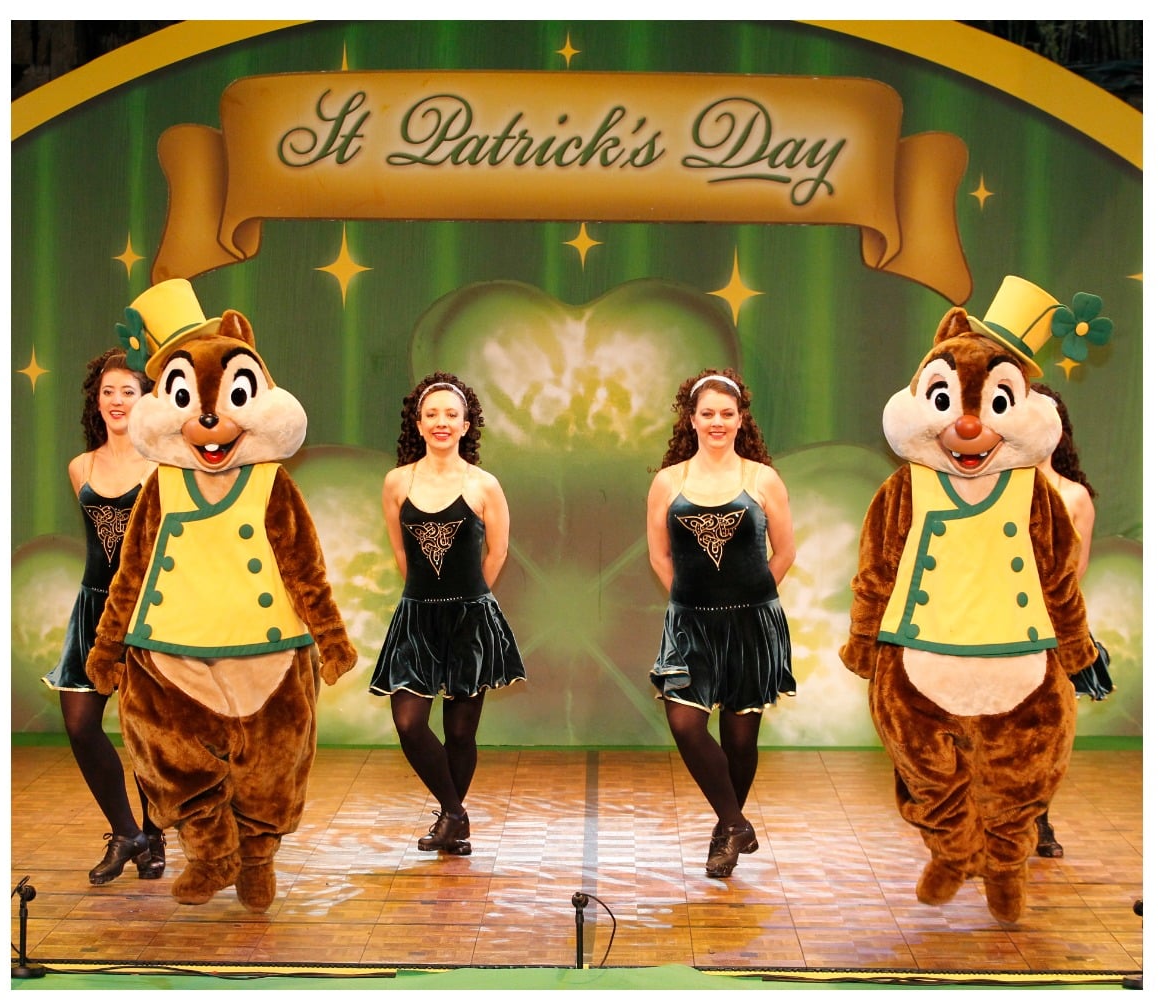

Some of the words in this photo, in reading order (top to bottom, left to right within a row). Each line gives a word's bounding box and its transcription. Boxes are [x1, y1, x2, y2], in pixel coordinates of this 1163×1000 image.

[277, 88, 371, 168] St
[386, 93, 666, 169] Patrick's
[681, 96, 847, 207] Day
